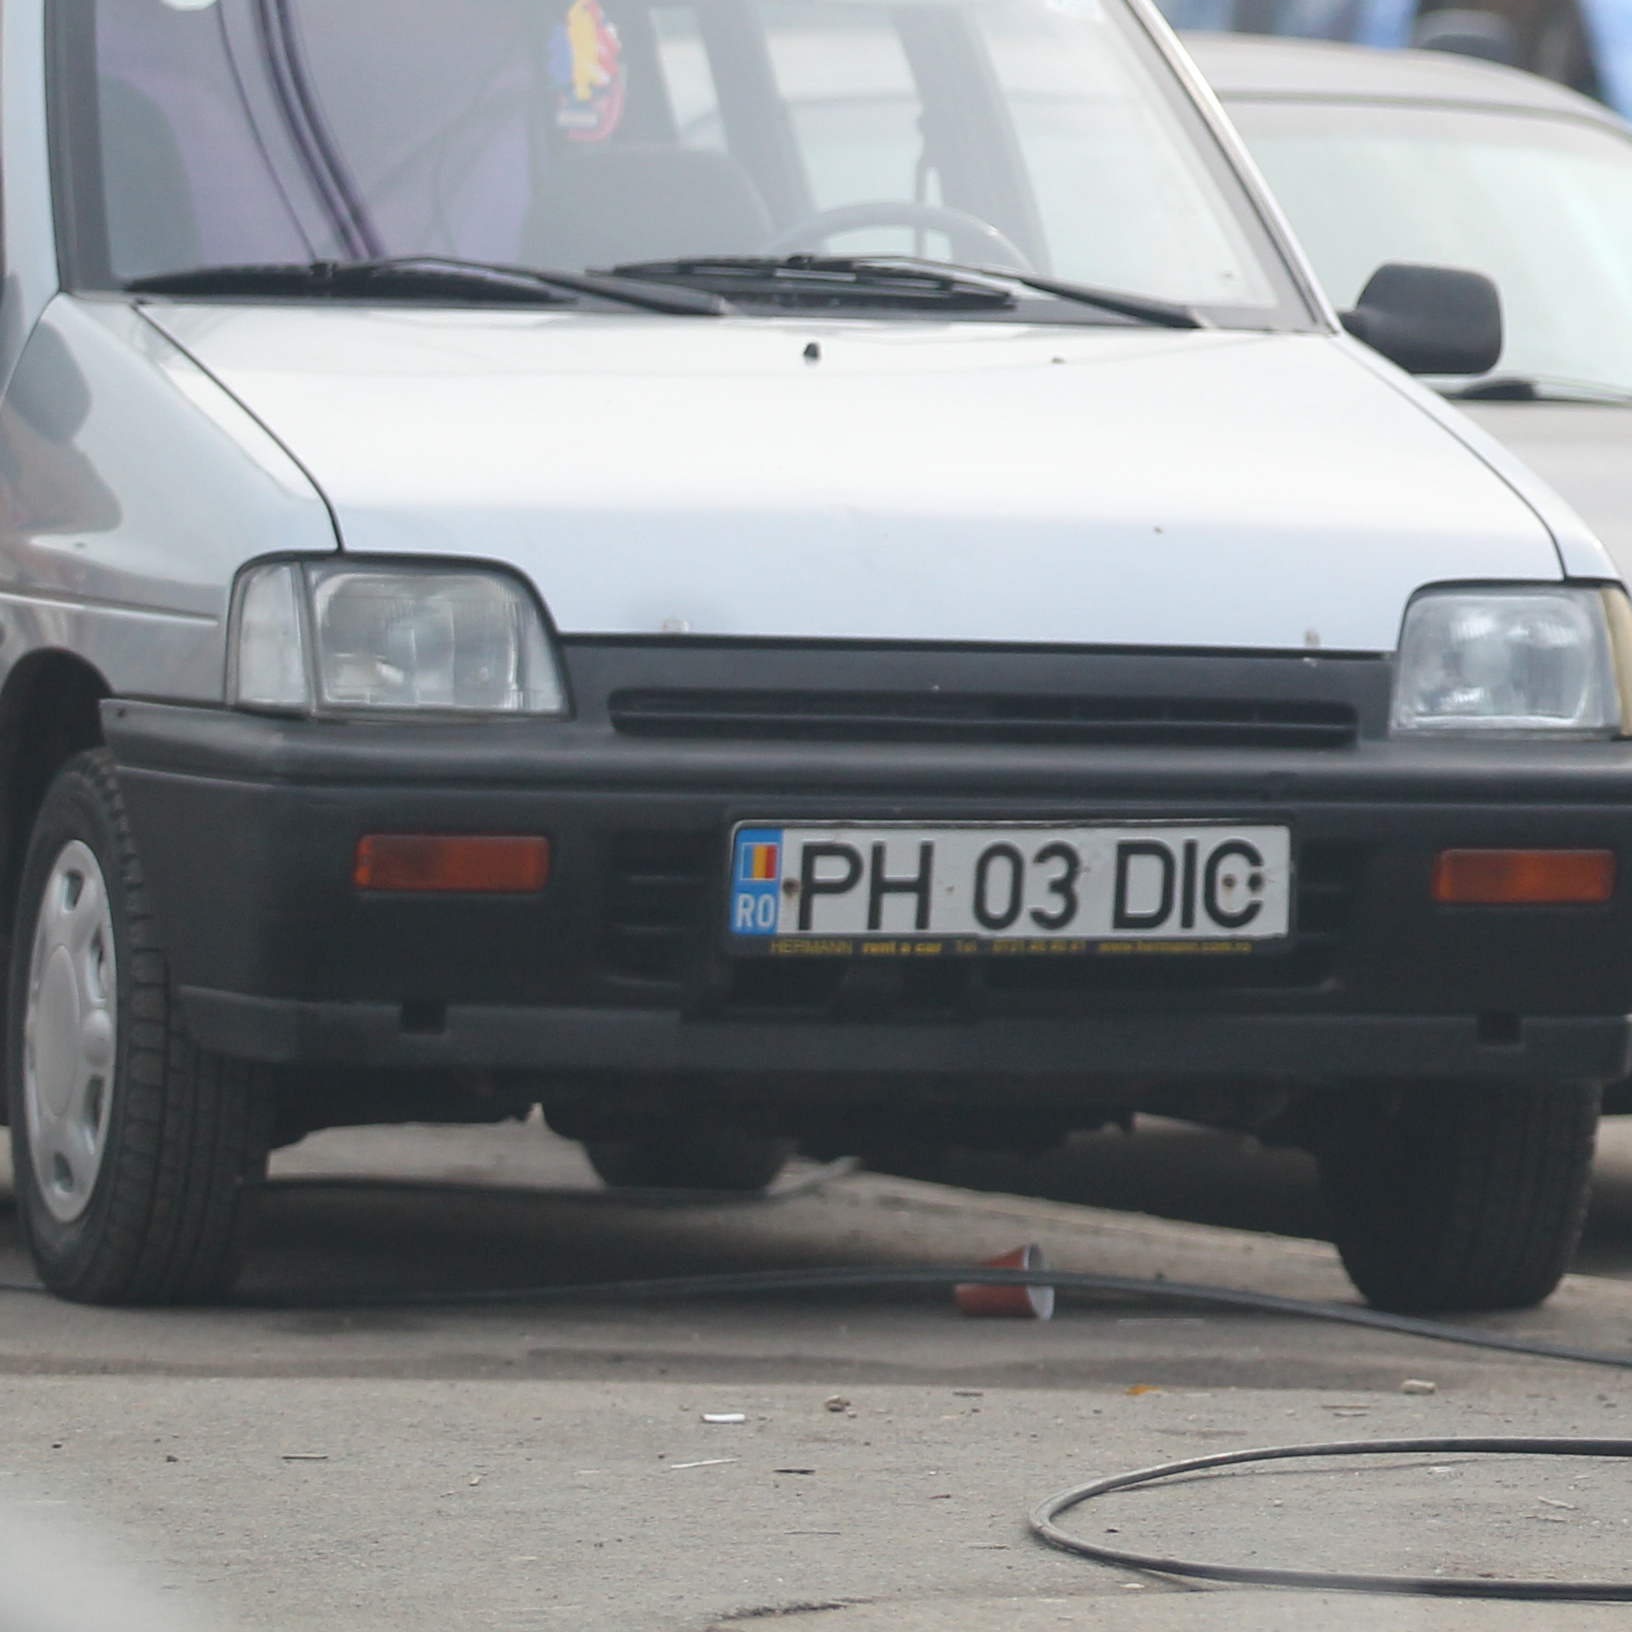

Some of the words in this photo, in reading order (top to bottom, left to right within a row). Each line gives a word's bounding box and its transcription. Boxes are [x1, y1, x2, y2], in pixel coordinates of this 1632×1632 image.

[736, 893, 777, 927] RO
[797, 840, 935, 930] PH
[974, 839, 1081, 930] 03
[1112, 838, 1263, 929] DIC
